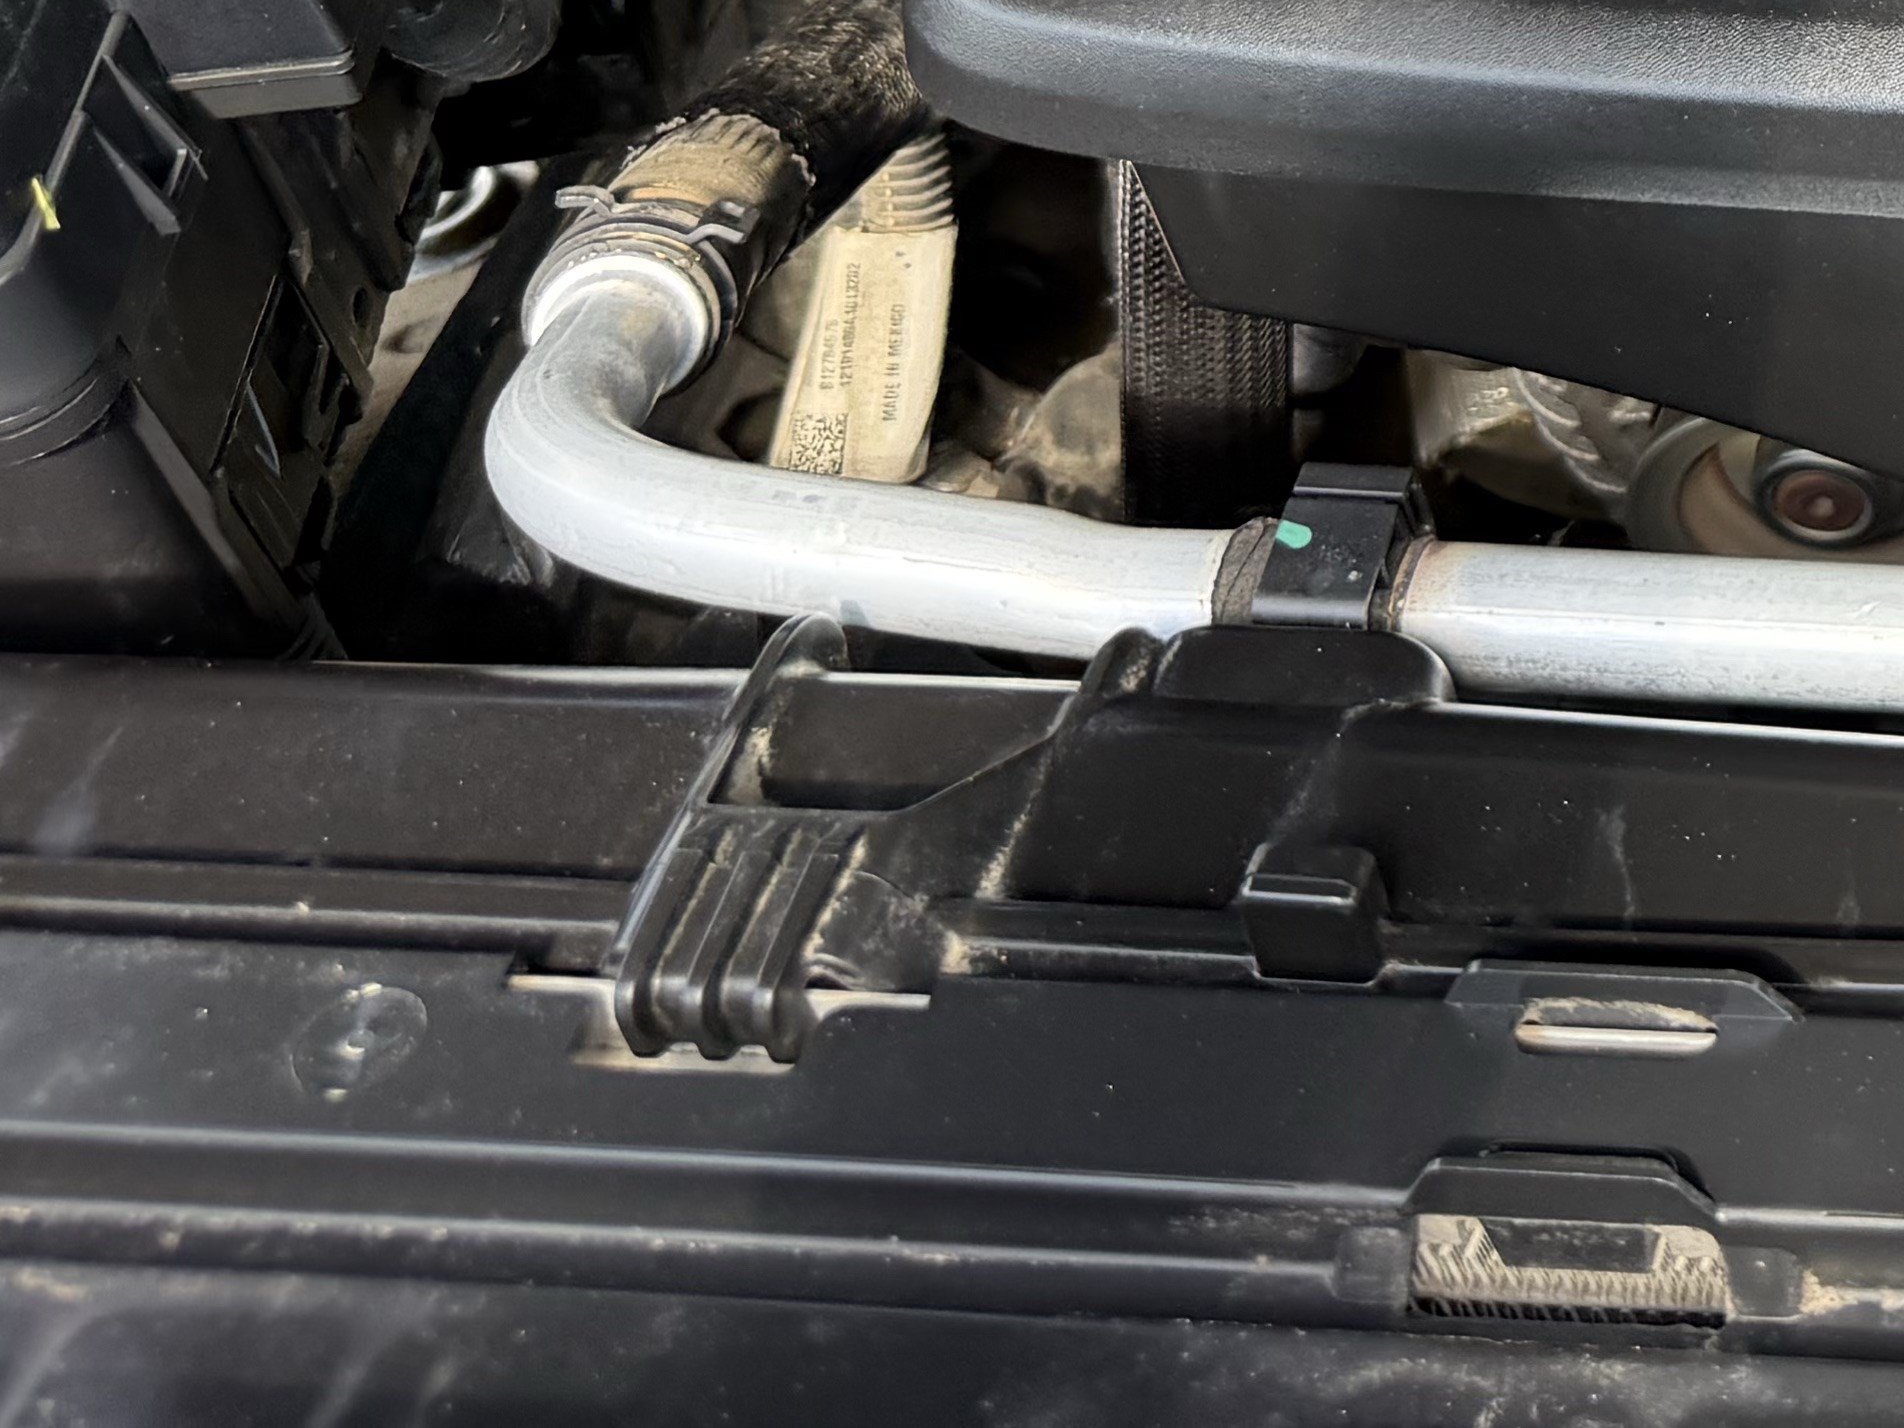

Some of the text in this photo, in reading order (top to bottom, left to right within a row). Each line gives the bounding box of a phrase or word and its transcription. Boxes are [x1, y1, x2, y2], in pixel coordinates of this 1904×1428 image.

[881, 304, 905, 420] MADE IN MEXICO
